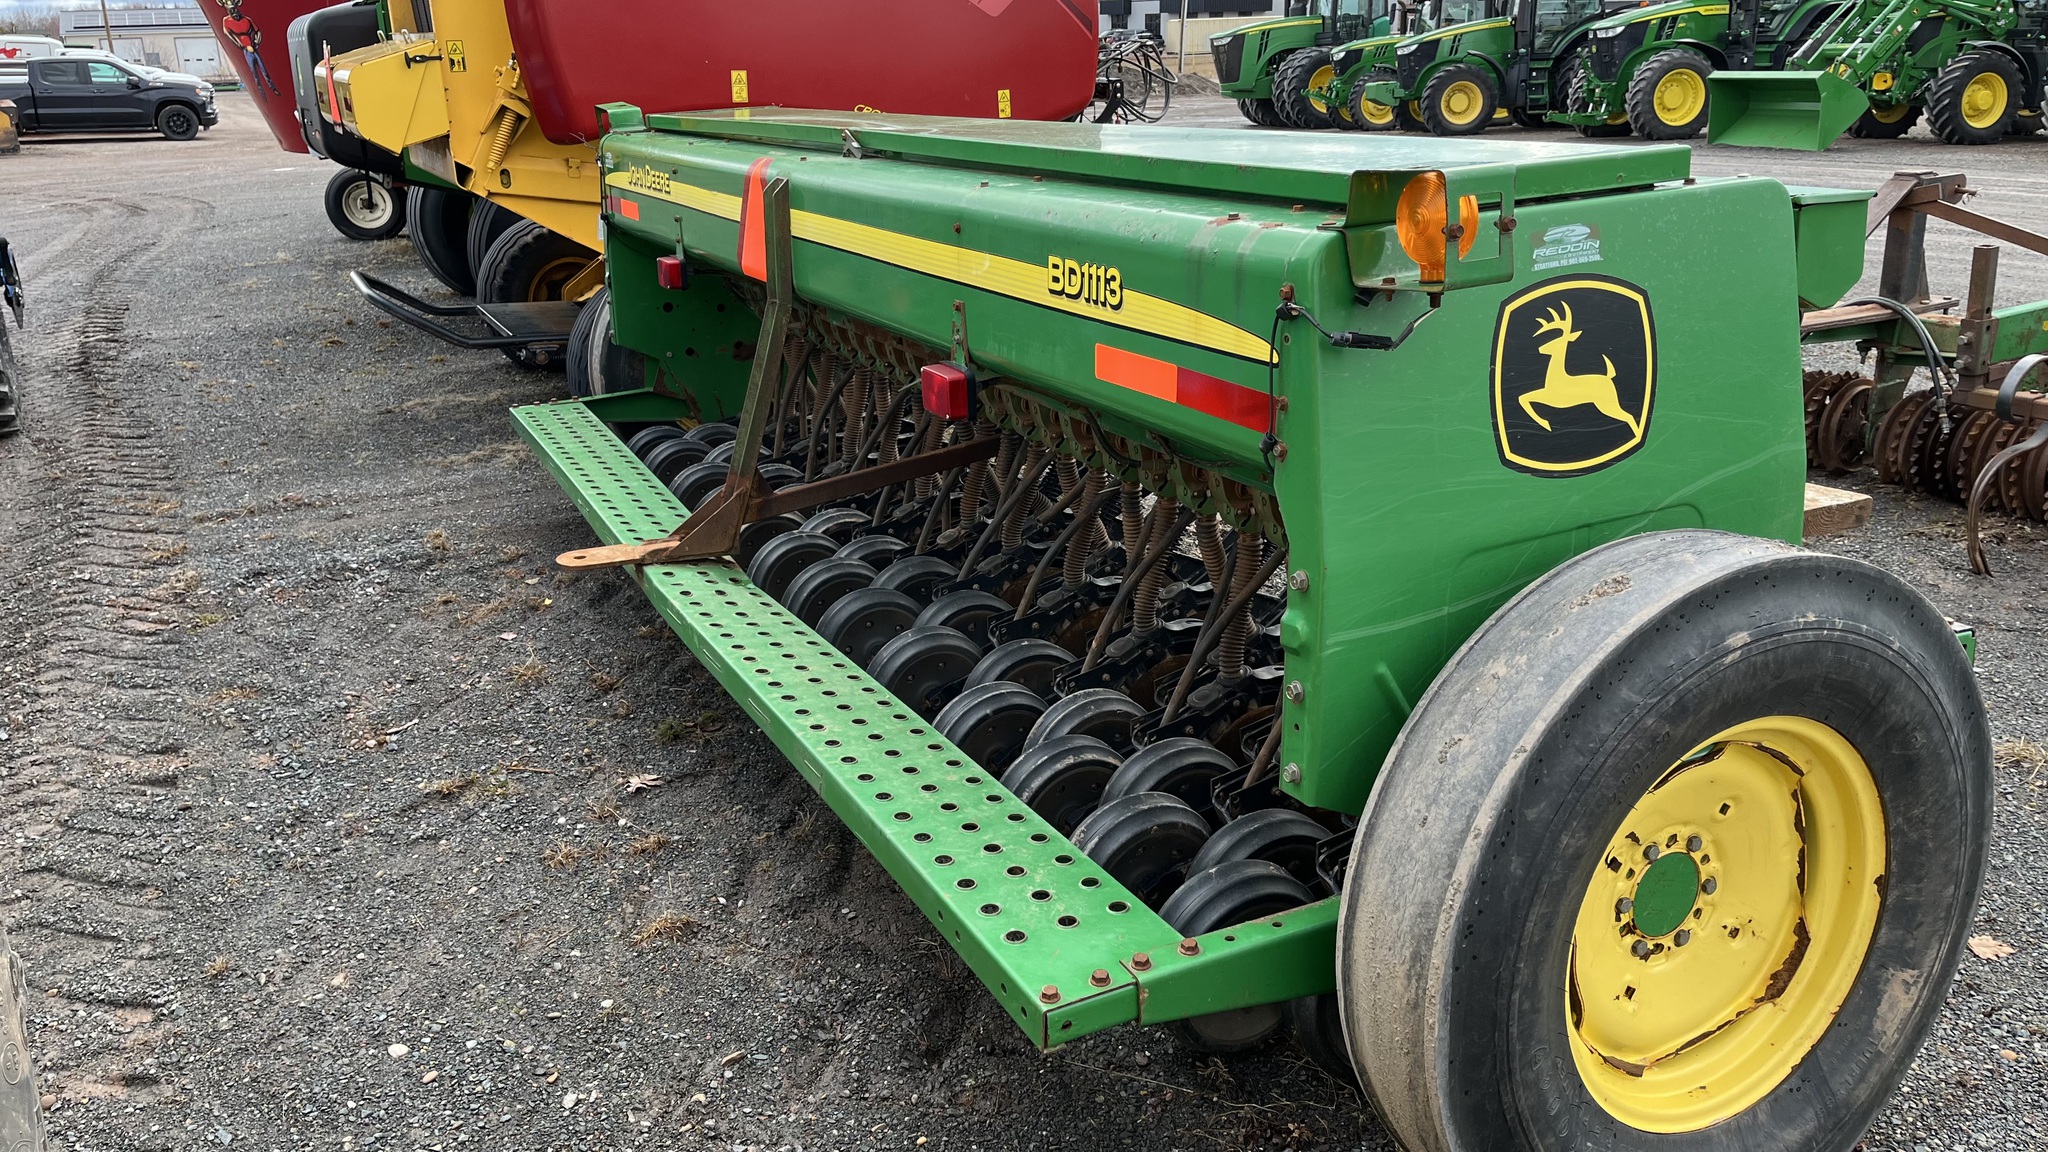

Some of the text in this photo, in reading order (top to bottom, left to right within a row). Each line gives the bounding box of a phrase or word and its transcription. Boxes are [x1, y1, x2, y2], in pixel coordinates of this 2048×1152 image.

[628, 162, 671, 195] JOHN DEERE
[1048, 255, 1122, 309] BD1113
